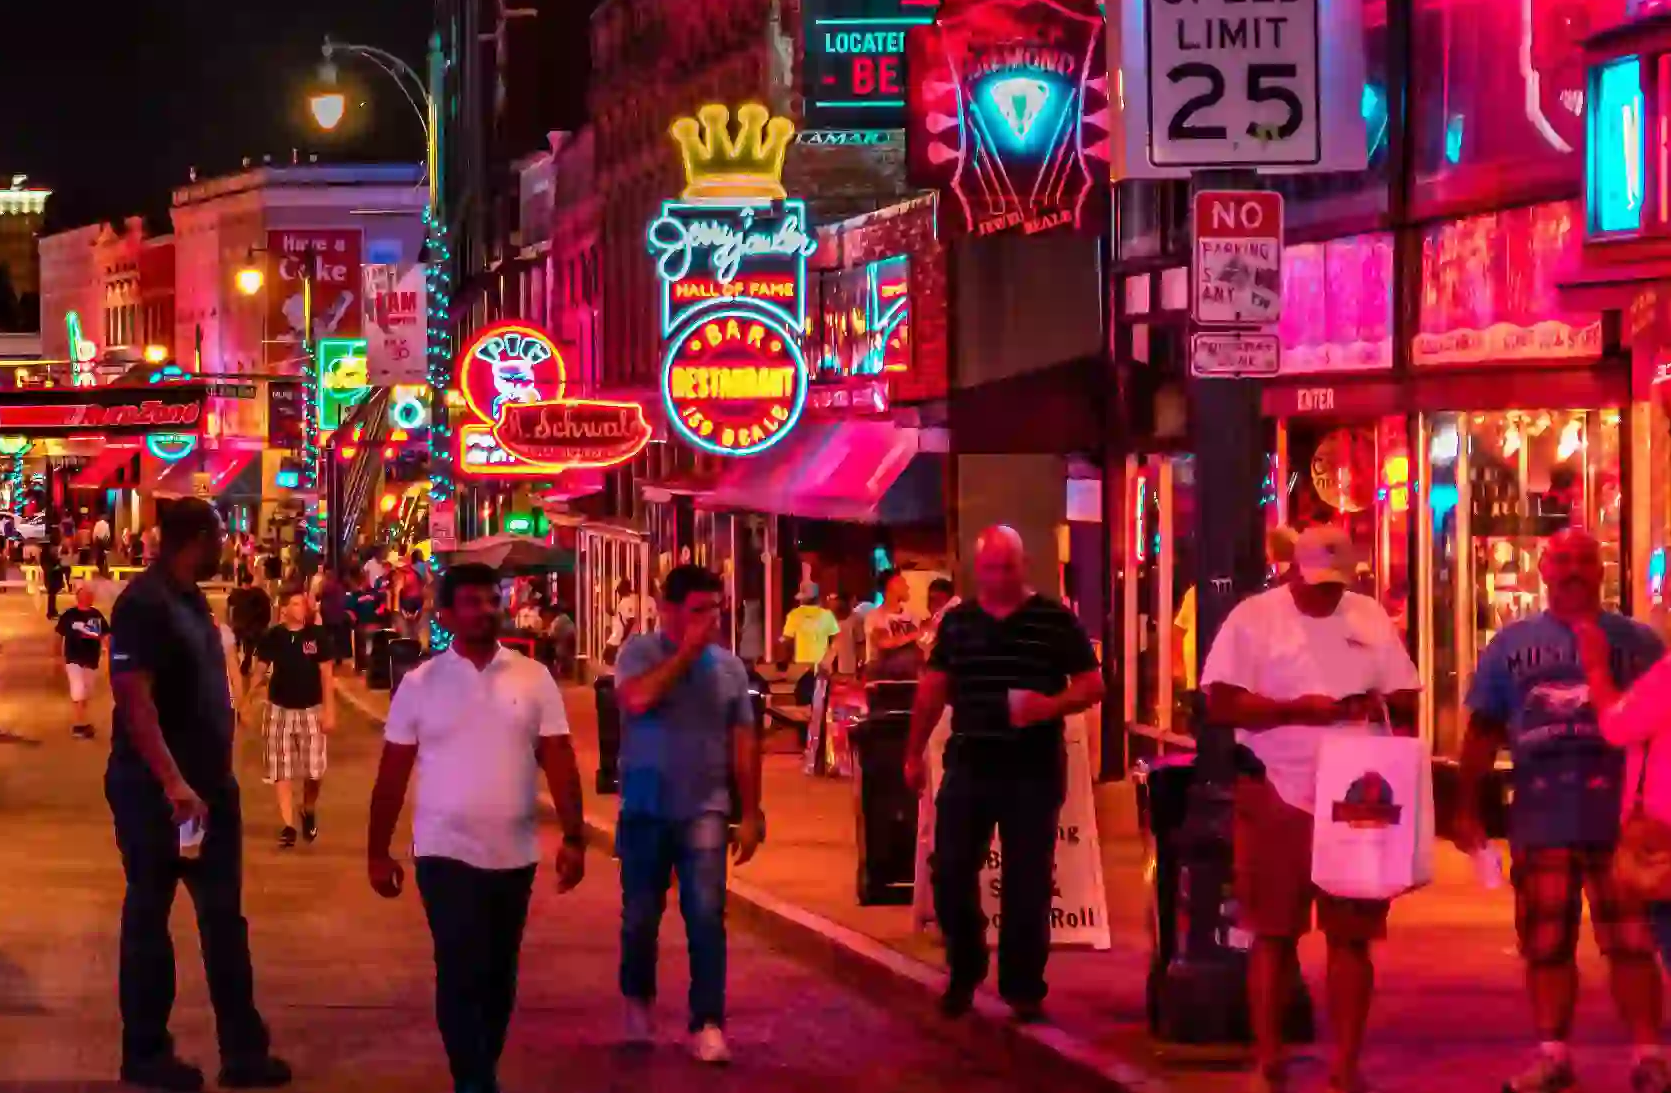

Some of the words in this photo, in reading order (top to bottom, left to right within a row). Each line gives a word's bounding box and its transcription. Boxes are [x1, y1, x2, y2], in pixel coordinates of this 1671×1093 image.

[1177, 17, 1288, 50] LIMIT
[1166, 61, 1304, 141] 25
[1212, 200, 1263, 230] NO
[676, 283, 720, 298] HALL
[749, 282, 795, 298] FAME
[704, 318, 766, 349] BAR
[1297, 388, 1335, 410] ENTER
[1051, 906, 1096, 929] Roll
